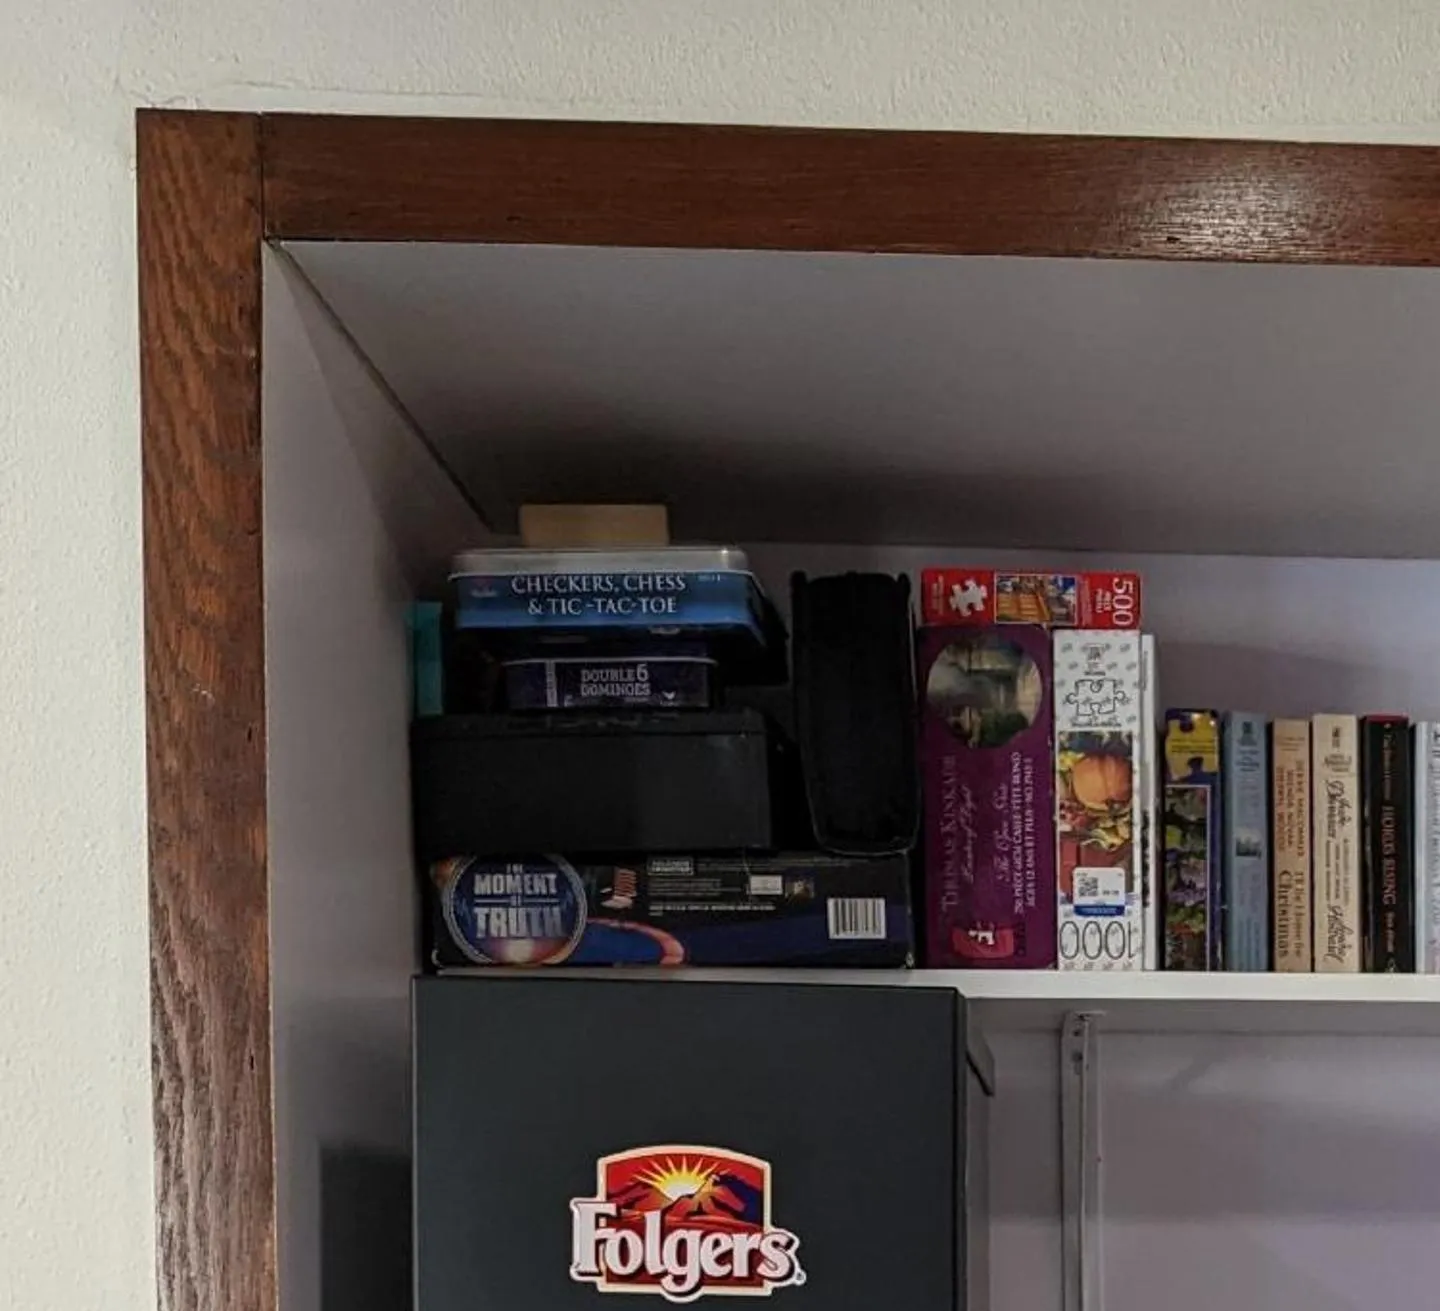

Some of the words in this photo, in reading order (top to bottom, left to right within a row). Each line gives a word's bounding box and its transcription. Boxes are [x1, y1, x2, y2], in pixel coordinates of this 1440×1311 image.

[510, 573, 620, 594] CHECKERS,
[623, 573, 686, 592] CHESS
[528, 599, 543, 614] &
[1112, 576, 1134, 626] 500
[580, 669, 636, 683] DOUBLE
[636, 664, 649, 682] 6
[580, 683, 651, 697] DOMINOES
[473, 873, 558, 896] MOMENT
[475, 906, 565, 938] TRUTH
[1278, 870, 1293, 958] Christmas
[1060, 921, 1134, 960] 1000
[572, 1200, 800, 1294] Folgers
